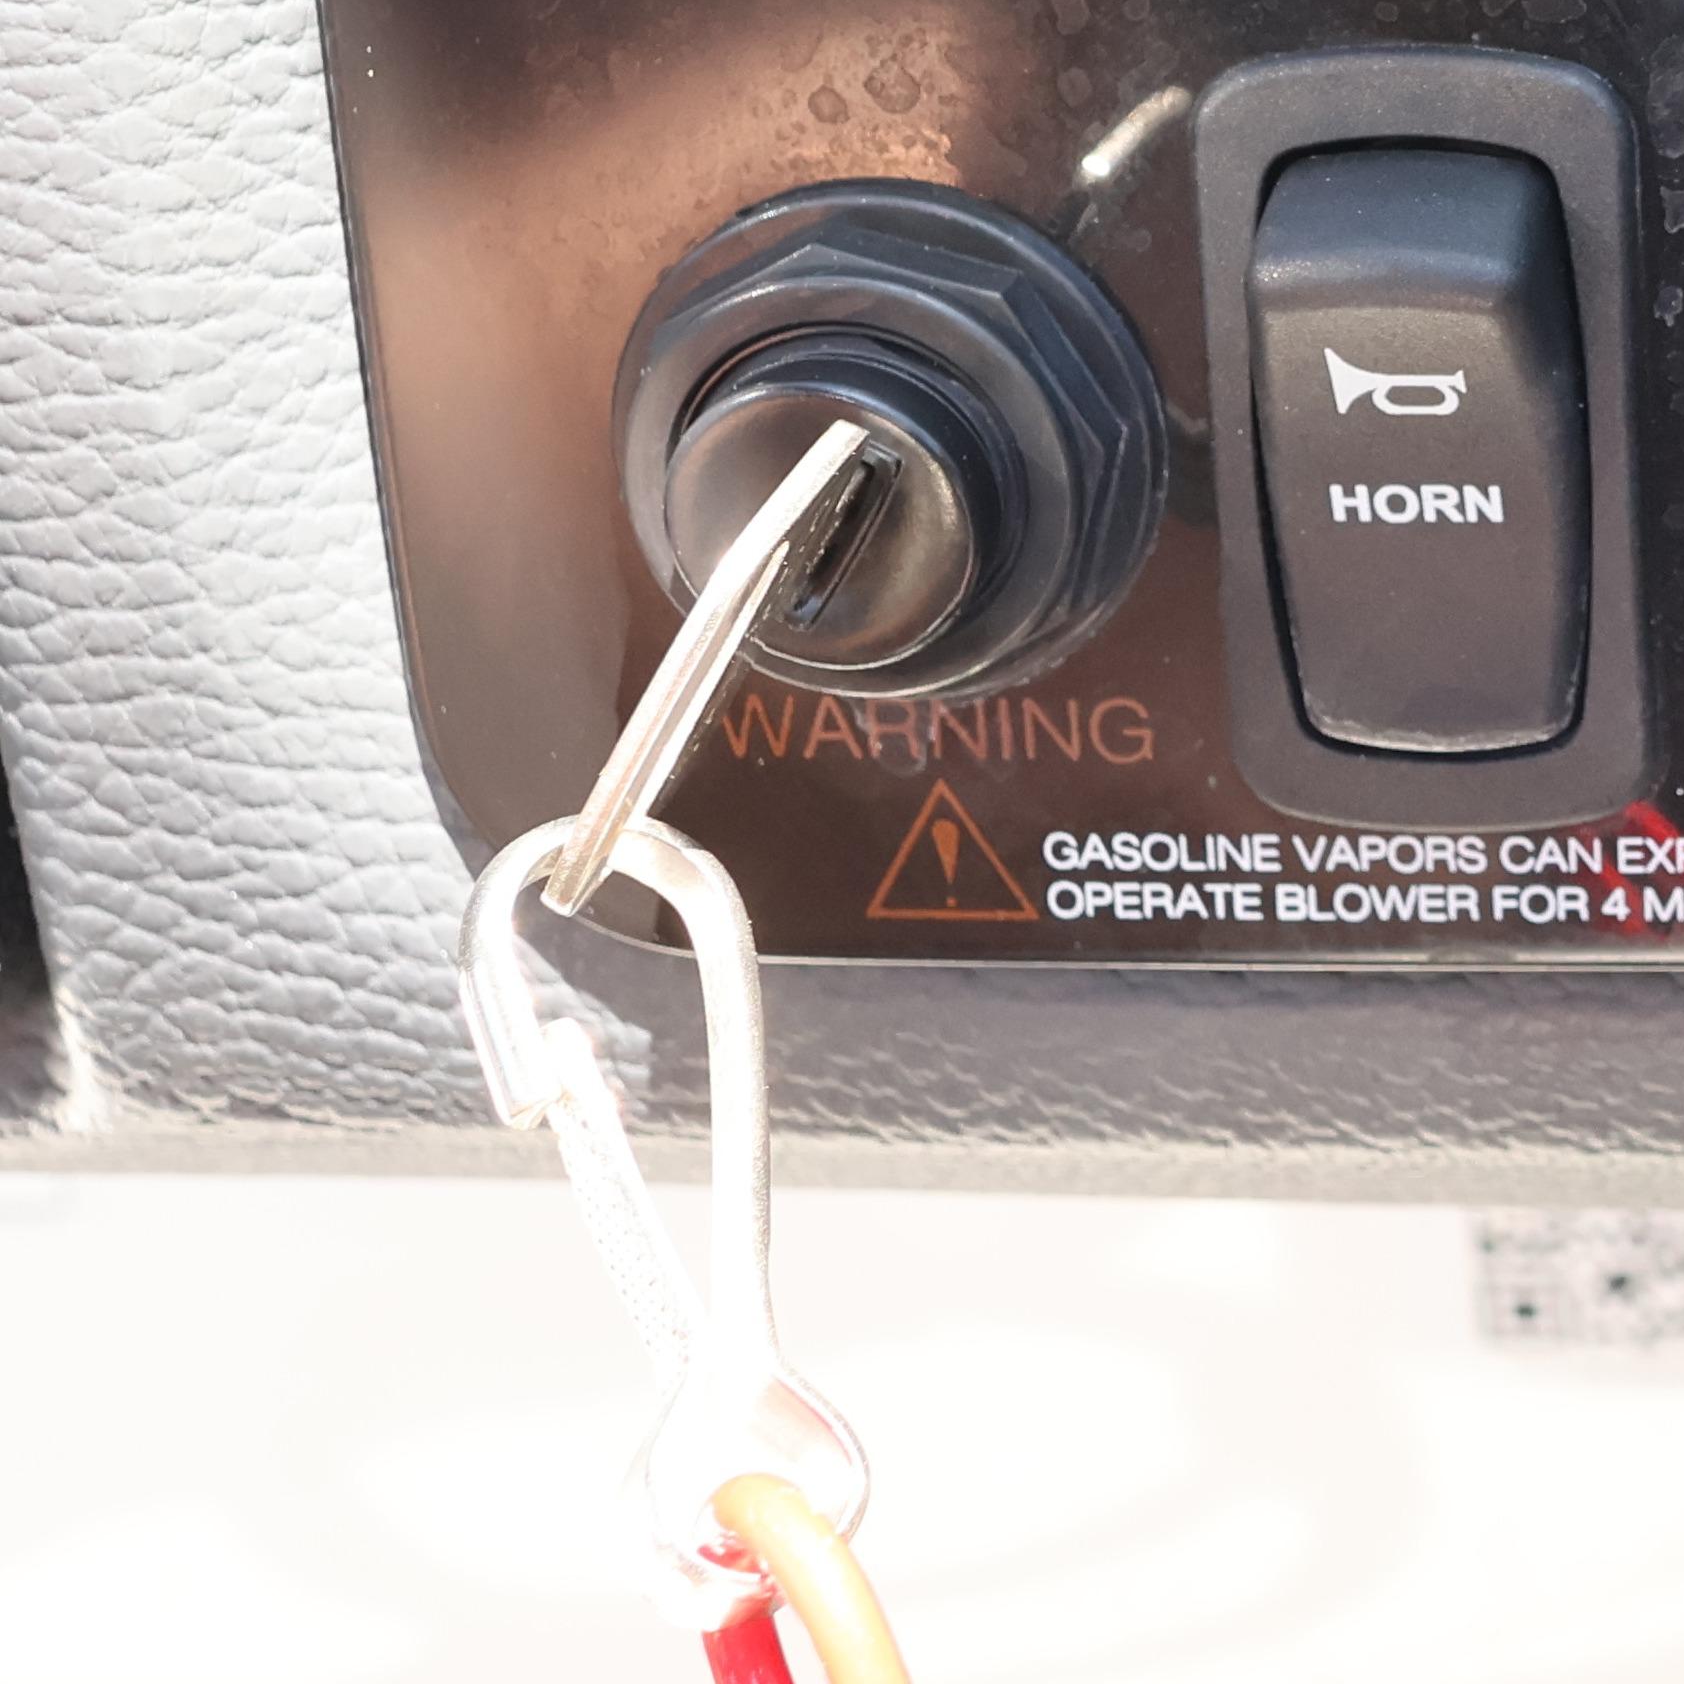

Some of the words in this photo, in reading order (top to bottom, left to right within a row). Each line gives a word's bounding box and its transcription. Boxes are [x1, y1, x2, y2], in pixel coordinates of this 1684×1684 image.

[1329, 484, 1504, 524] HORN
[723, 694, 1155, 762] WARNING
[1042, 831, 1280, 873] GASOLINE
[1294, 834, 1487, 873] VAPORS
[1498, 836, 1602, 873] CAN
[1047, 882, 1263, 920] OPERATE
[1277, 884, 1478, 922] BLOWER
[1492, 885, 1589, 922] FOR
[1601, 887, 1630, 922] 4
